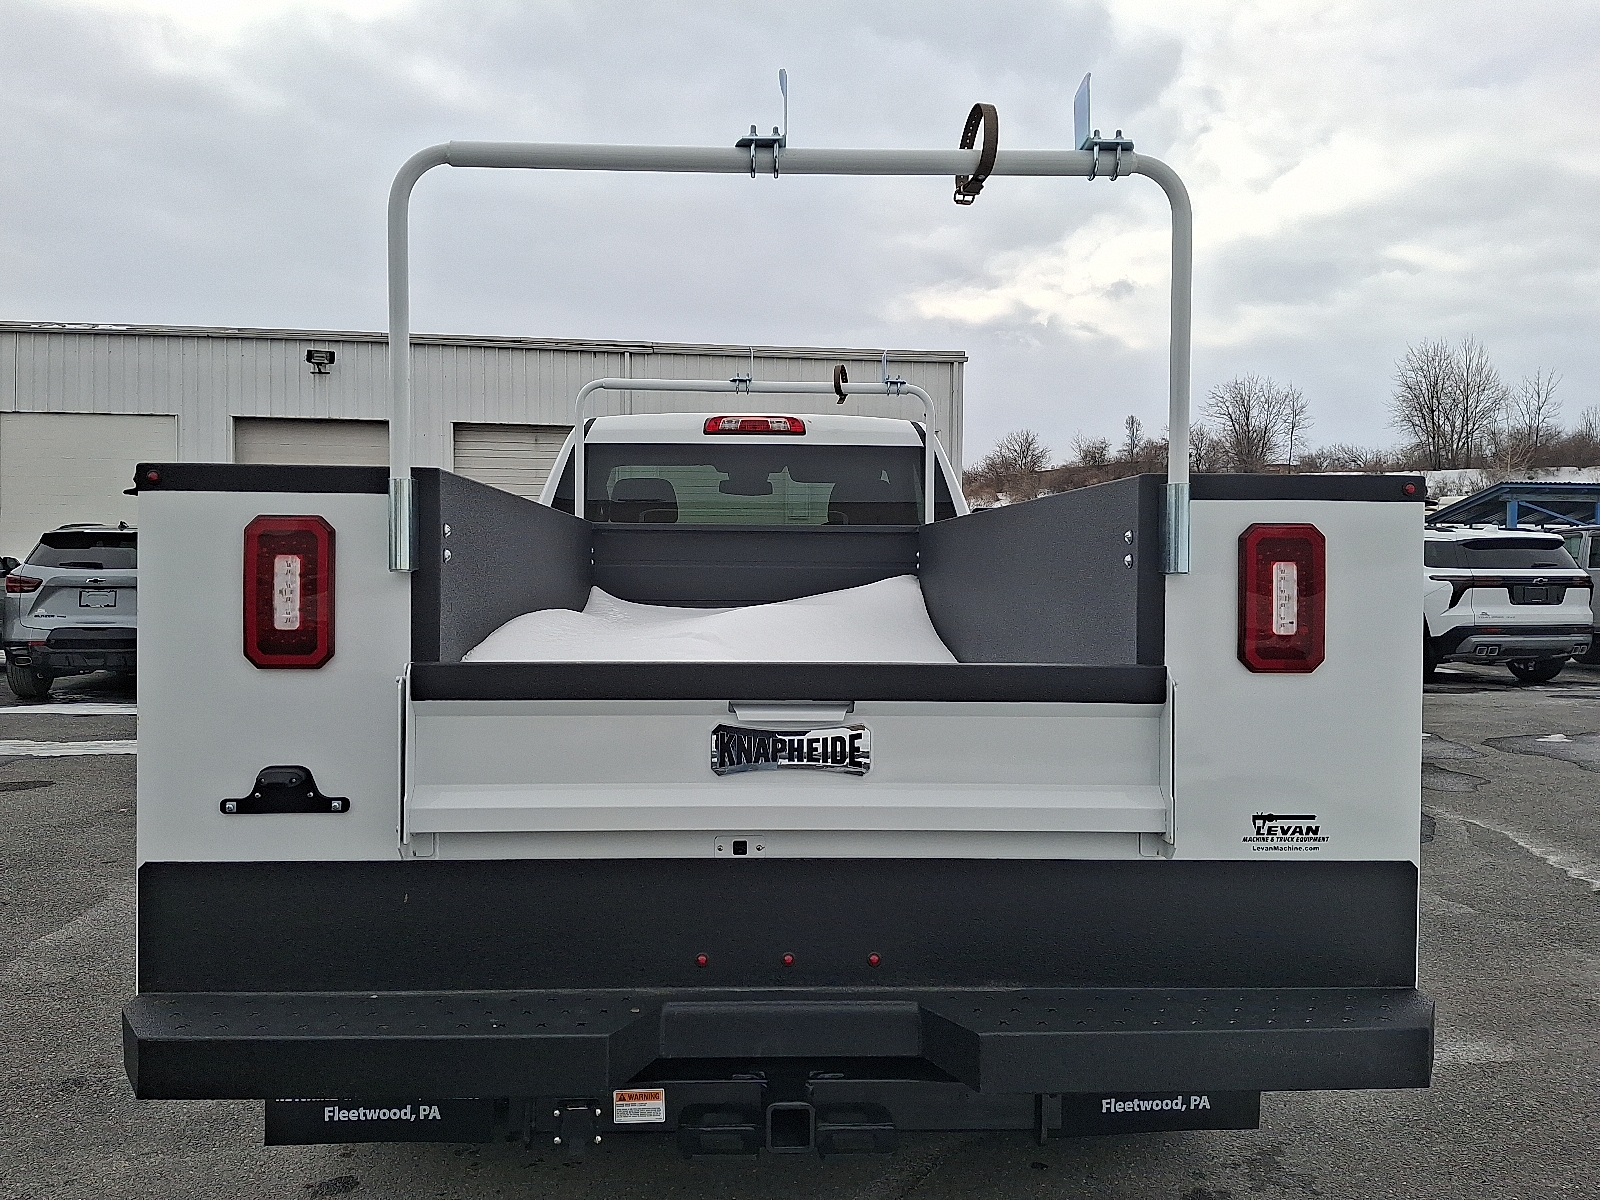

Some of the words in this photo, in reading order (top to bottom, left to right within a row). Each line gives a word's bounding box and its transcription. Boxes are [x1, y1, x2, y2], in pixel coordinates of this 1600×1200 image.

[718, 731, 863, 769] KNAPHEIDE
[1255, 825, 1321, 836] LEVAN
[627, 1092, 660, 1101] WARNING
[1101, 1095, 1187, 1113] Fleetwood,
[1189, 1095, 1211, 1110] PA
[324, 1104, 416, 1122] Fleetwood,
[419, 1105, 442, 1120] PA
